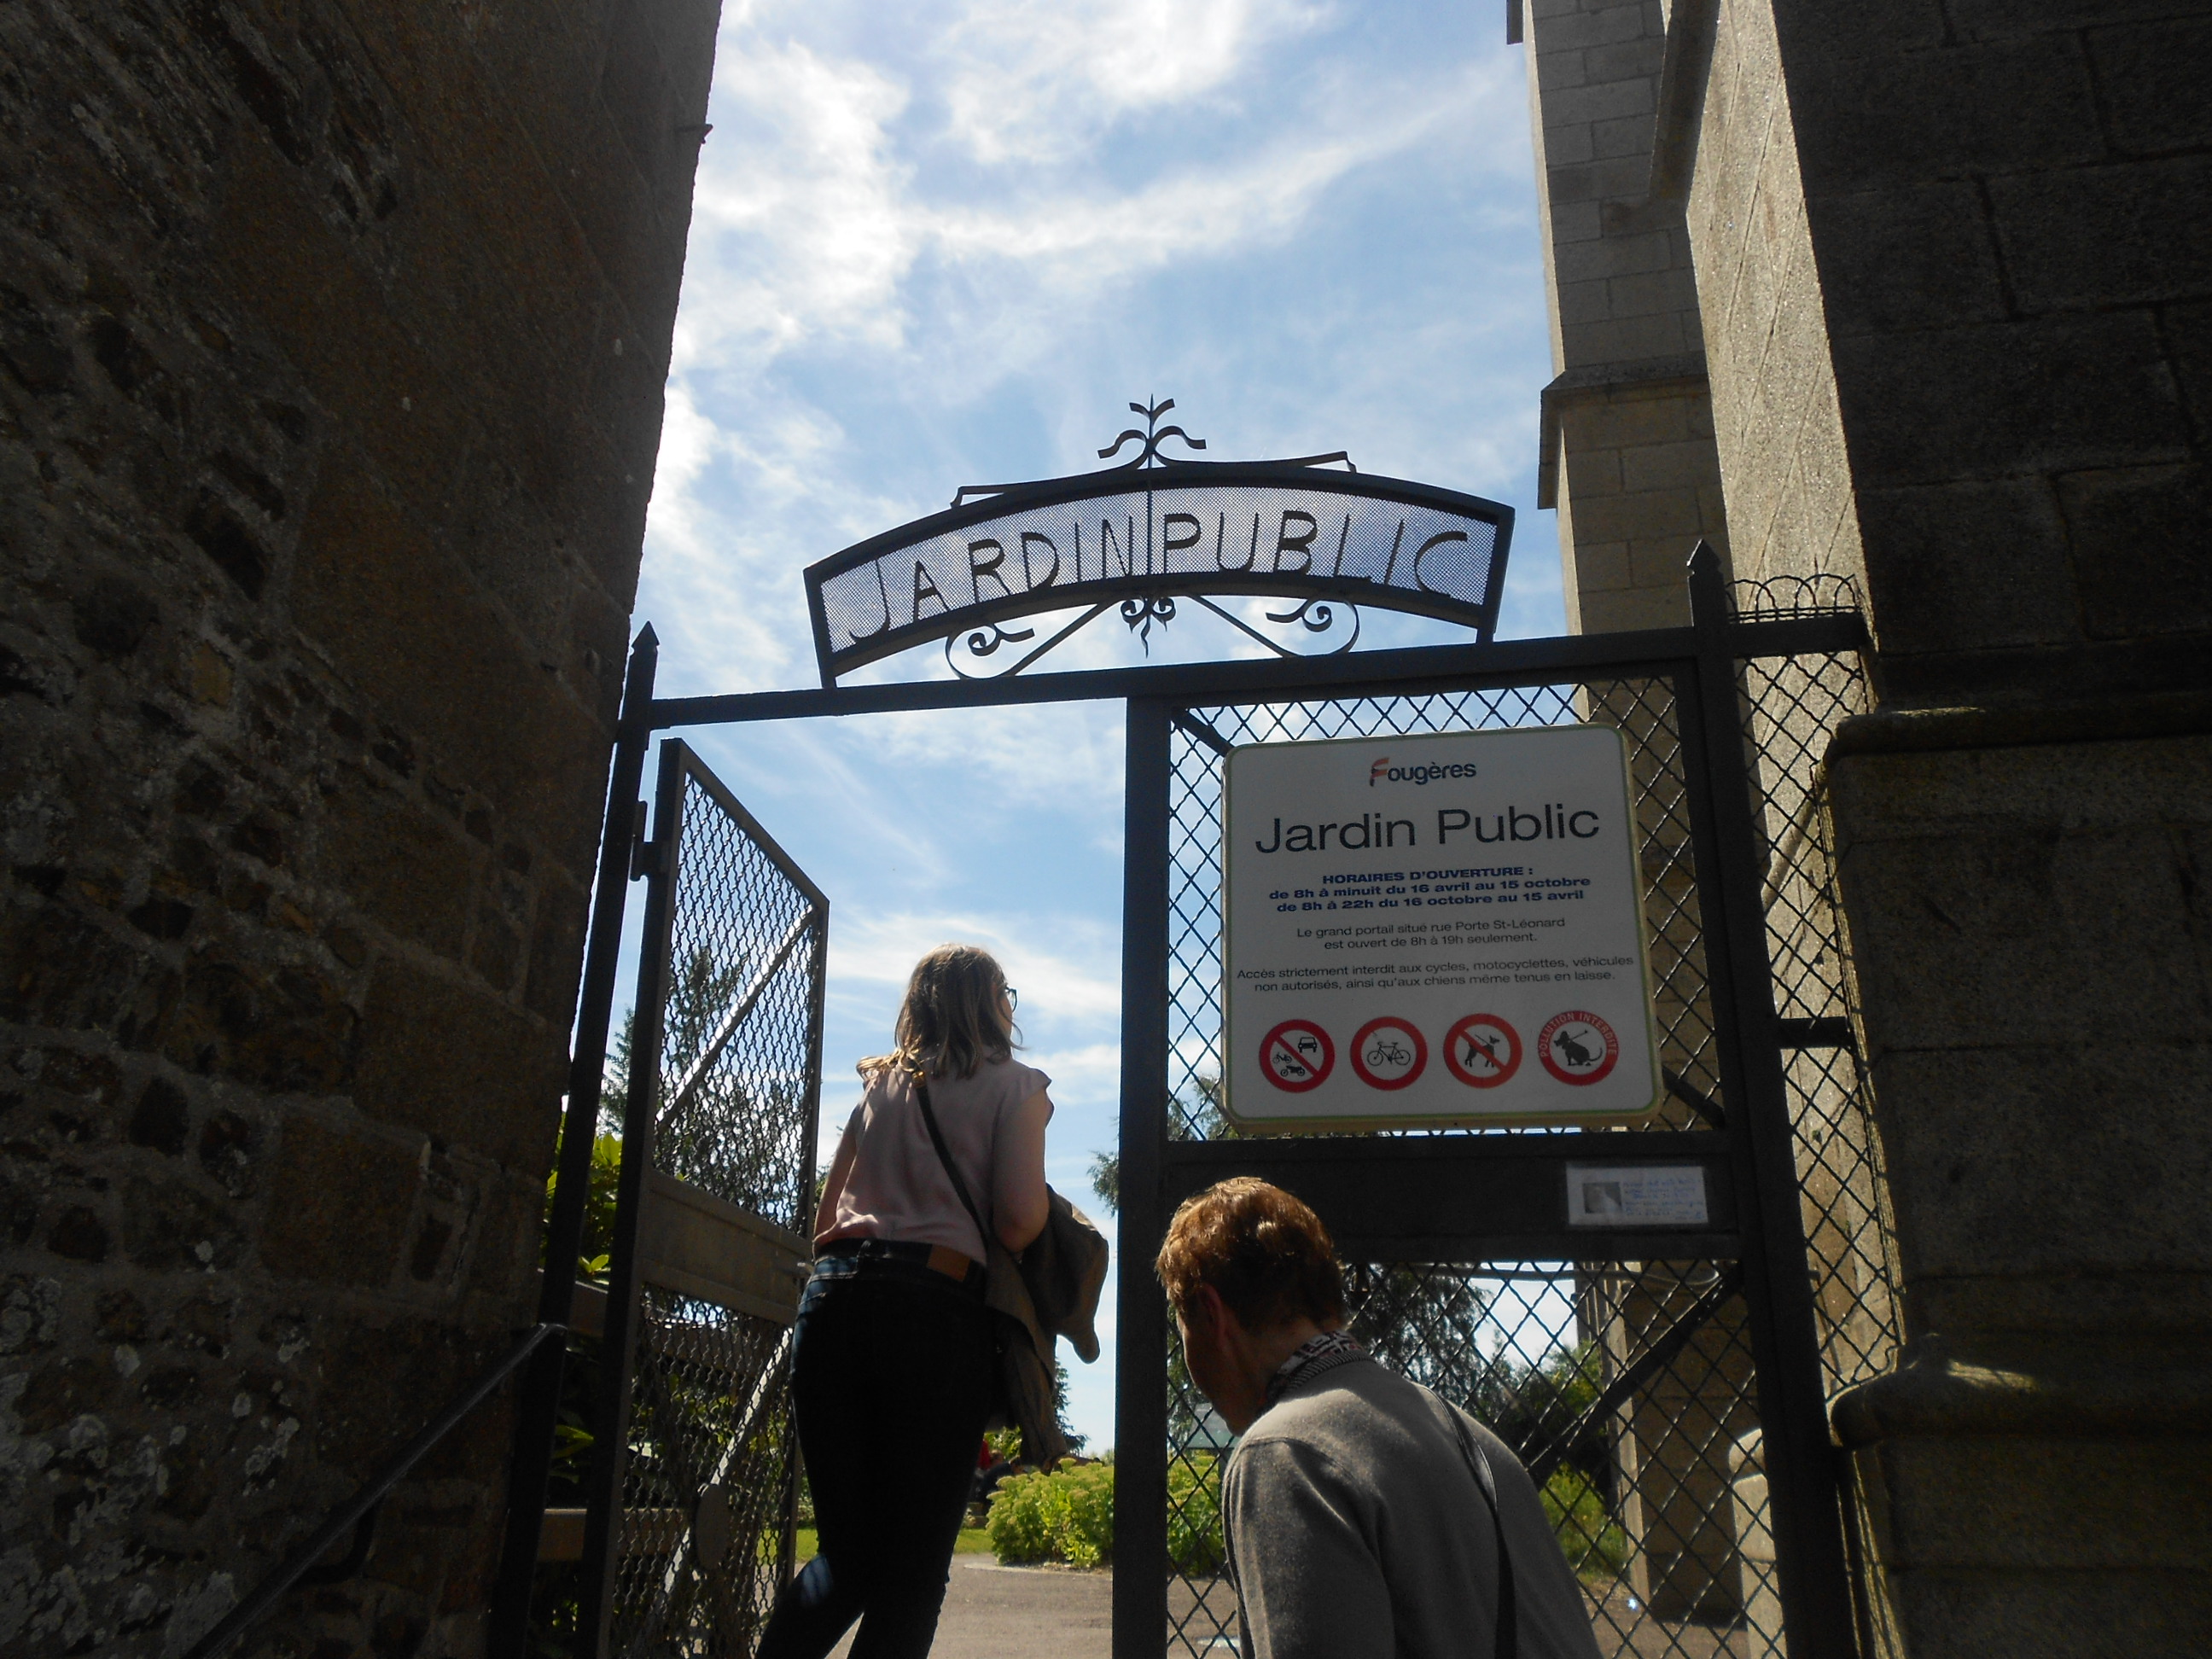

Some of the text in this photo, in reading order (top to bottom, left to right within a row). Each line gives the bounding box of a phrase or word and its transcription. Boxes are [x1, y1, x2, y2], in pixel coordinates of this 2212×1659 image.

[848, 510, 1469, 639] JARDIN PUBLIC
[1369, 757, 1476, 787] Fougères
[1255, 803, 1599, 853] Jardin Public
[1269, 877, 1592, 899] de 8h à minuit du 16 avril au 15 octobre
[1322, 872, 1405, 884] HORAIRES
[1277, 890, 1584, 912] de 8h à 22h du 16 octobre au 15 avril
[1297, 917, 1565, 938] Le grand portail situé rue Porte St-Léonard
[1324, 932, 1537, 949] est ouvert de 8h à 19h seulement.
[1237, 956, 1633, 979] Accès strictement interdit aux cycles, motocyclettes, véhicules
[1254, 969, 1615, 992] non autorisés, ainsi qu'aux chiens même tenus en laisse.
[1539, 1012, 1617, 1057] POLLUTION INTERDITE
